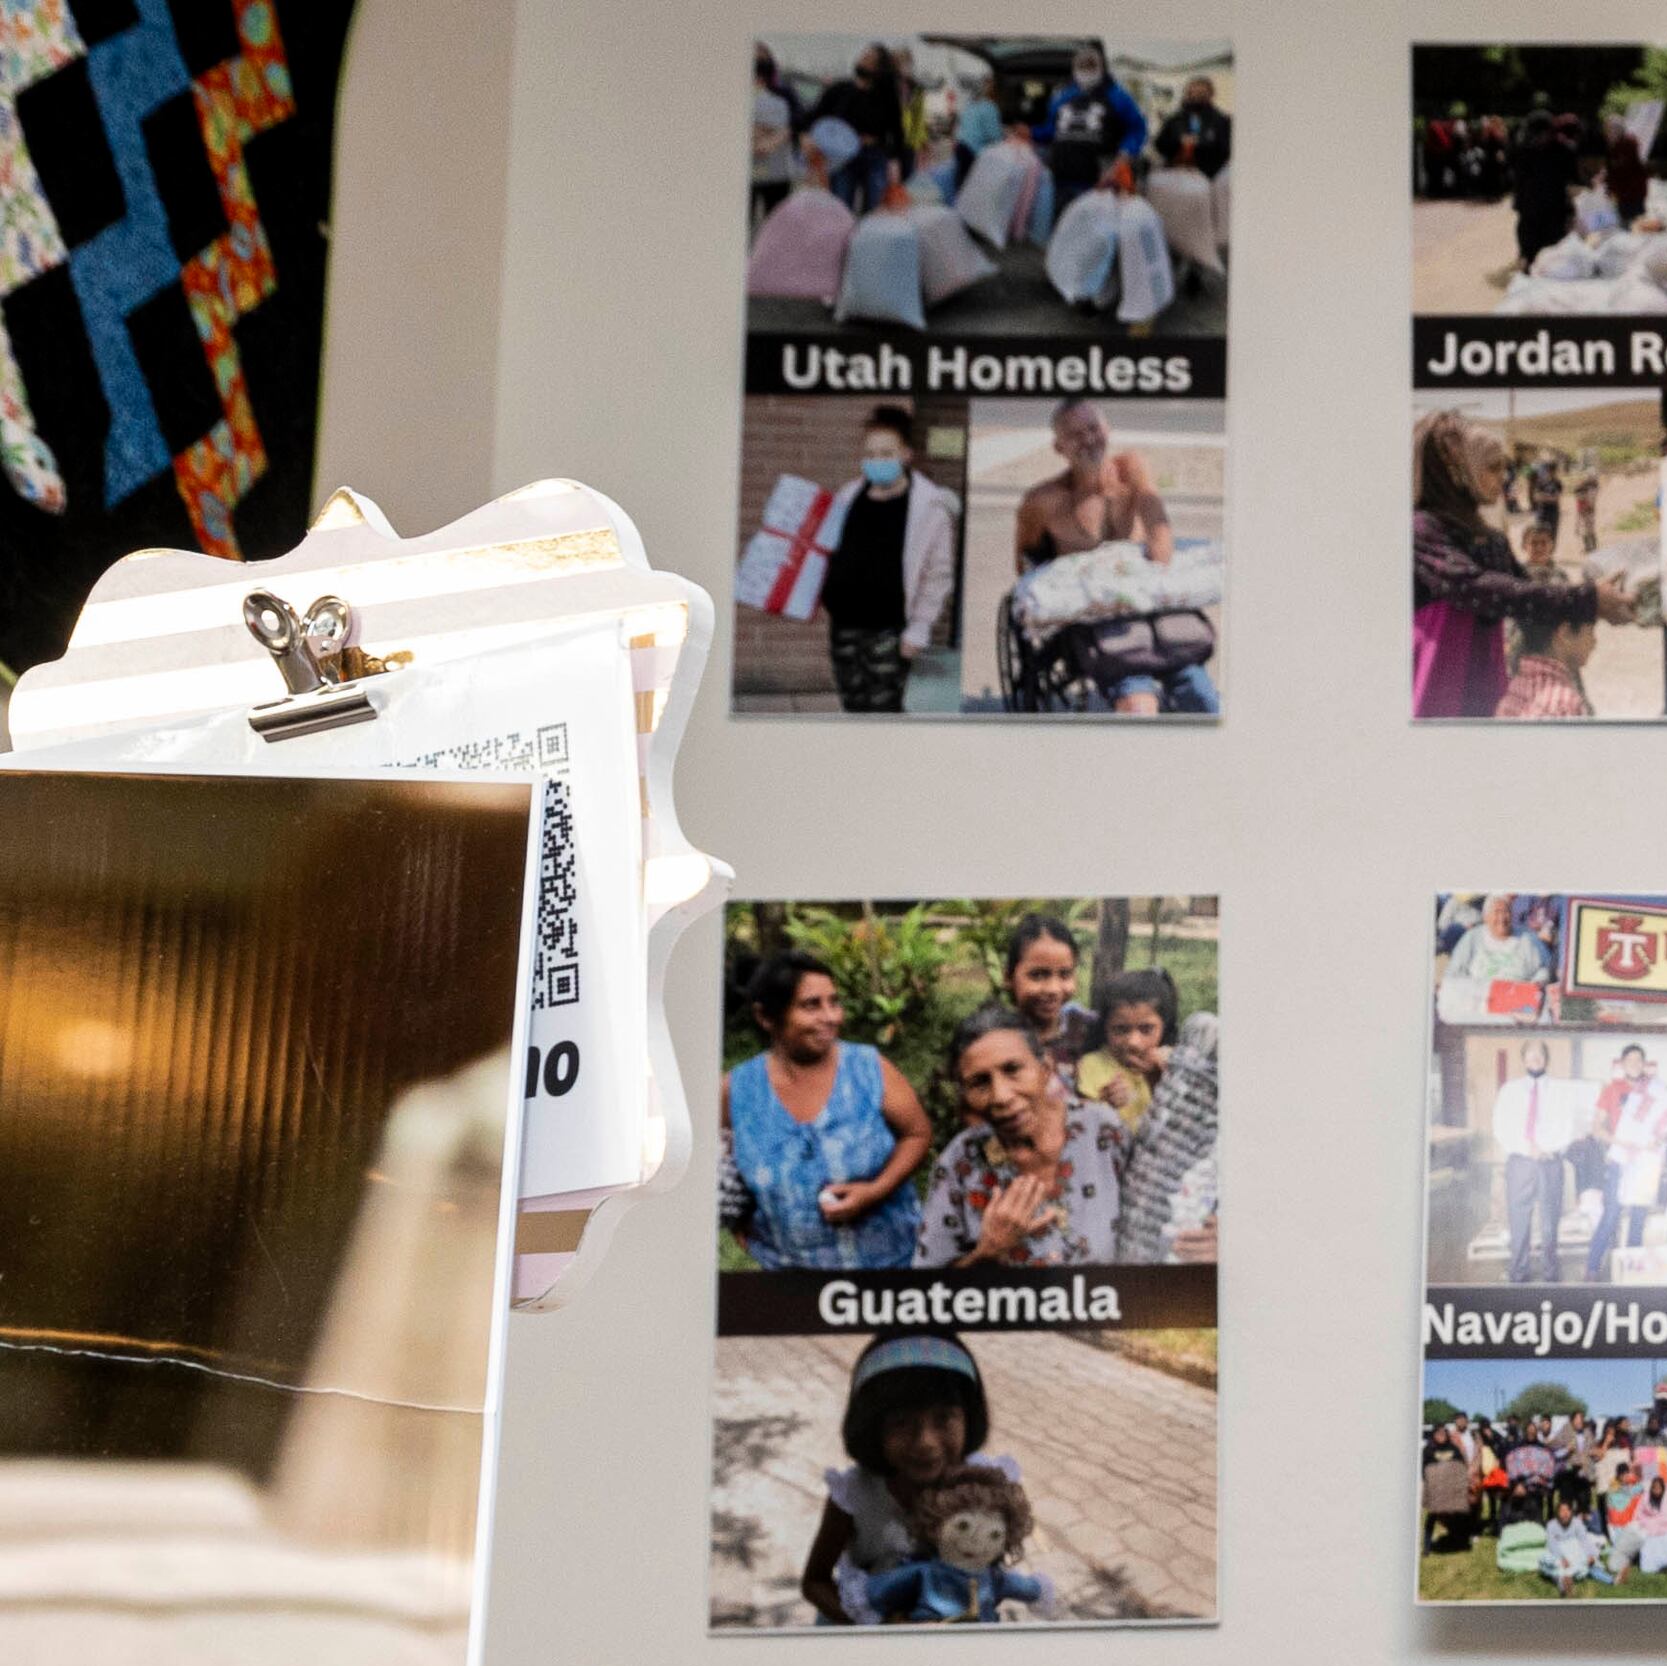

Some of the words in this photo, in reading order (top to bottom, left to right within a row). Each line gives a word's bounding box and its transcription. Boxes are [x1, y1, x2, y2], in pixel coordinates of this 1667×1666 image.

[783, 341, 913, 392] Utah
[928, 345, 1191, 393] Homeless
[1427, 331, 1614, 380] Jordan
[819, 1281, 1121, 1328] Guatemala
